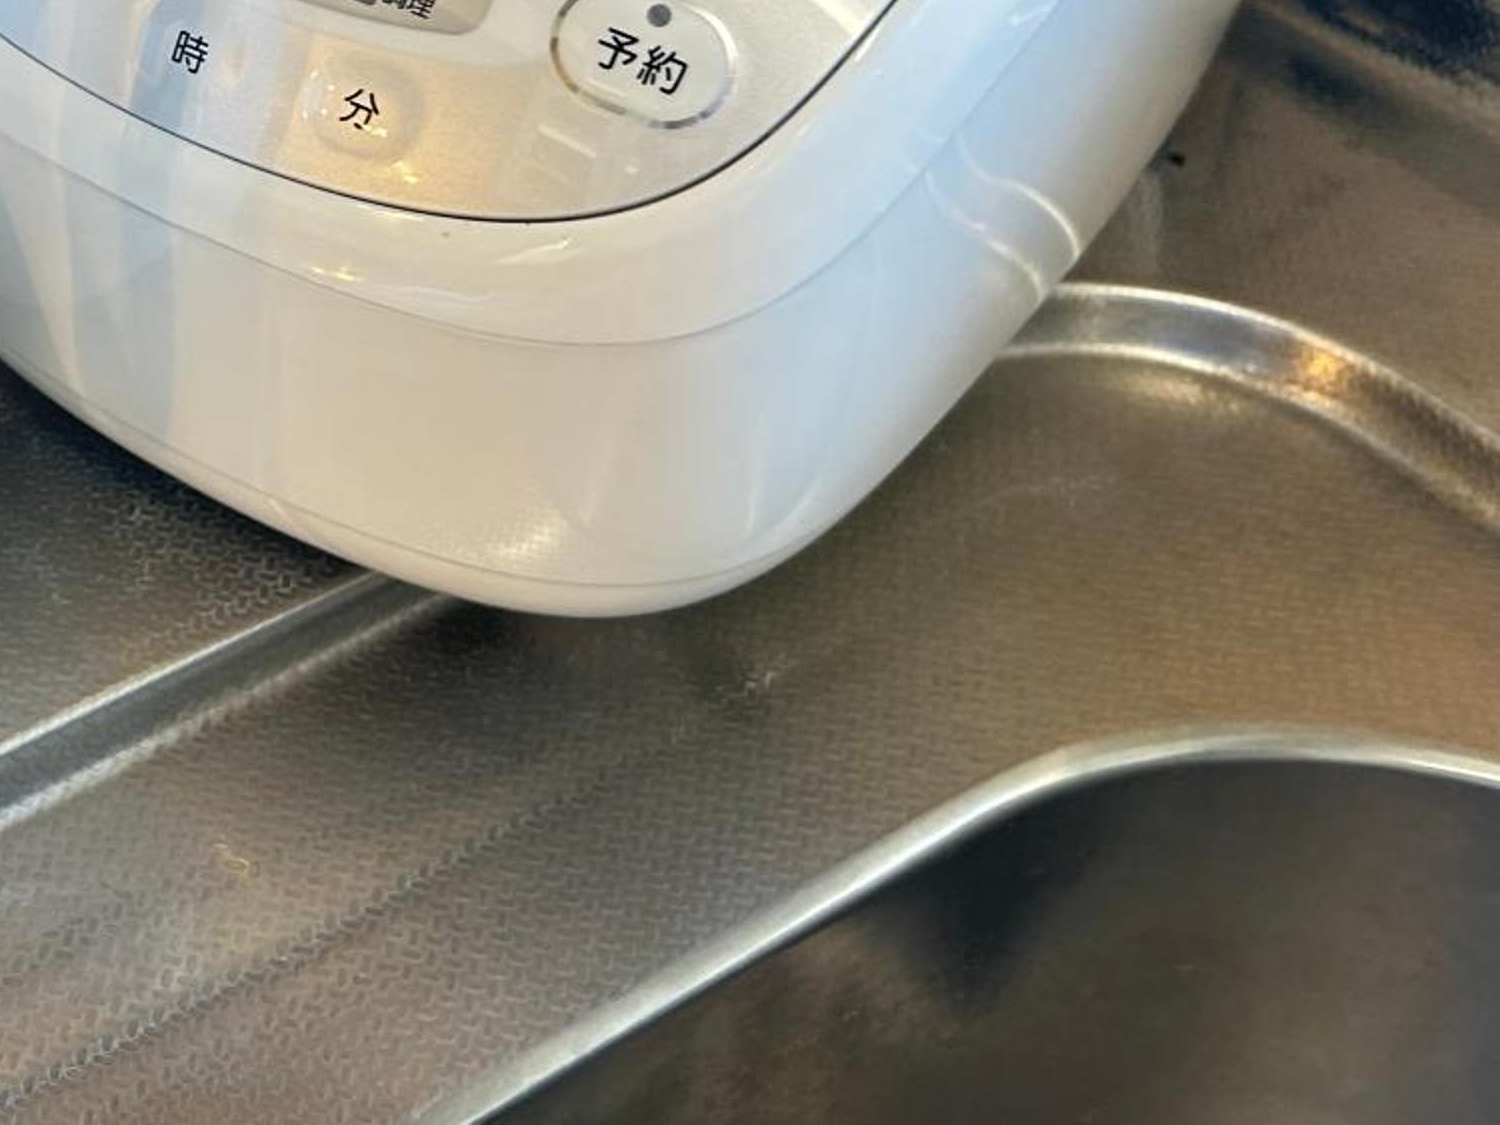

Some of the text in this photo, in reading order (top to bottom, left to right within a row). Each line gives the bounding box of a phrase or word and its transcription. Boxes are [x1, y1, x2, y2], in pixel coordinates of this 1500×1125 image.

[171, 30, 209, 74] 時
[597, 26, 689, 96] 予約
[339, 88, 379, 130] 分
